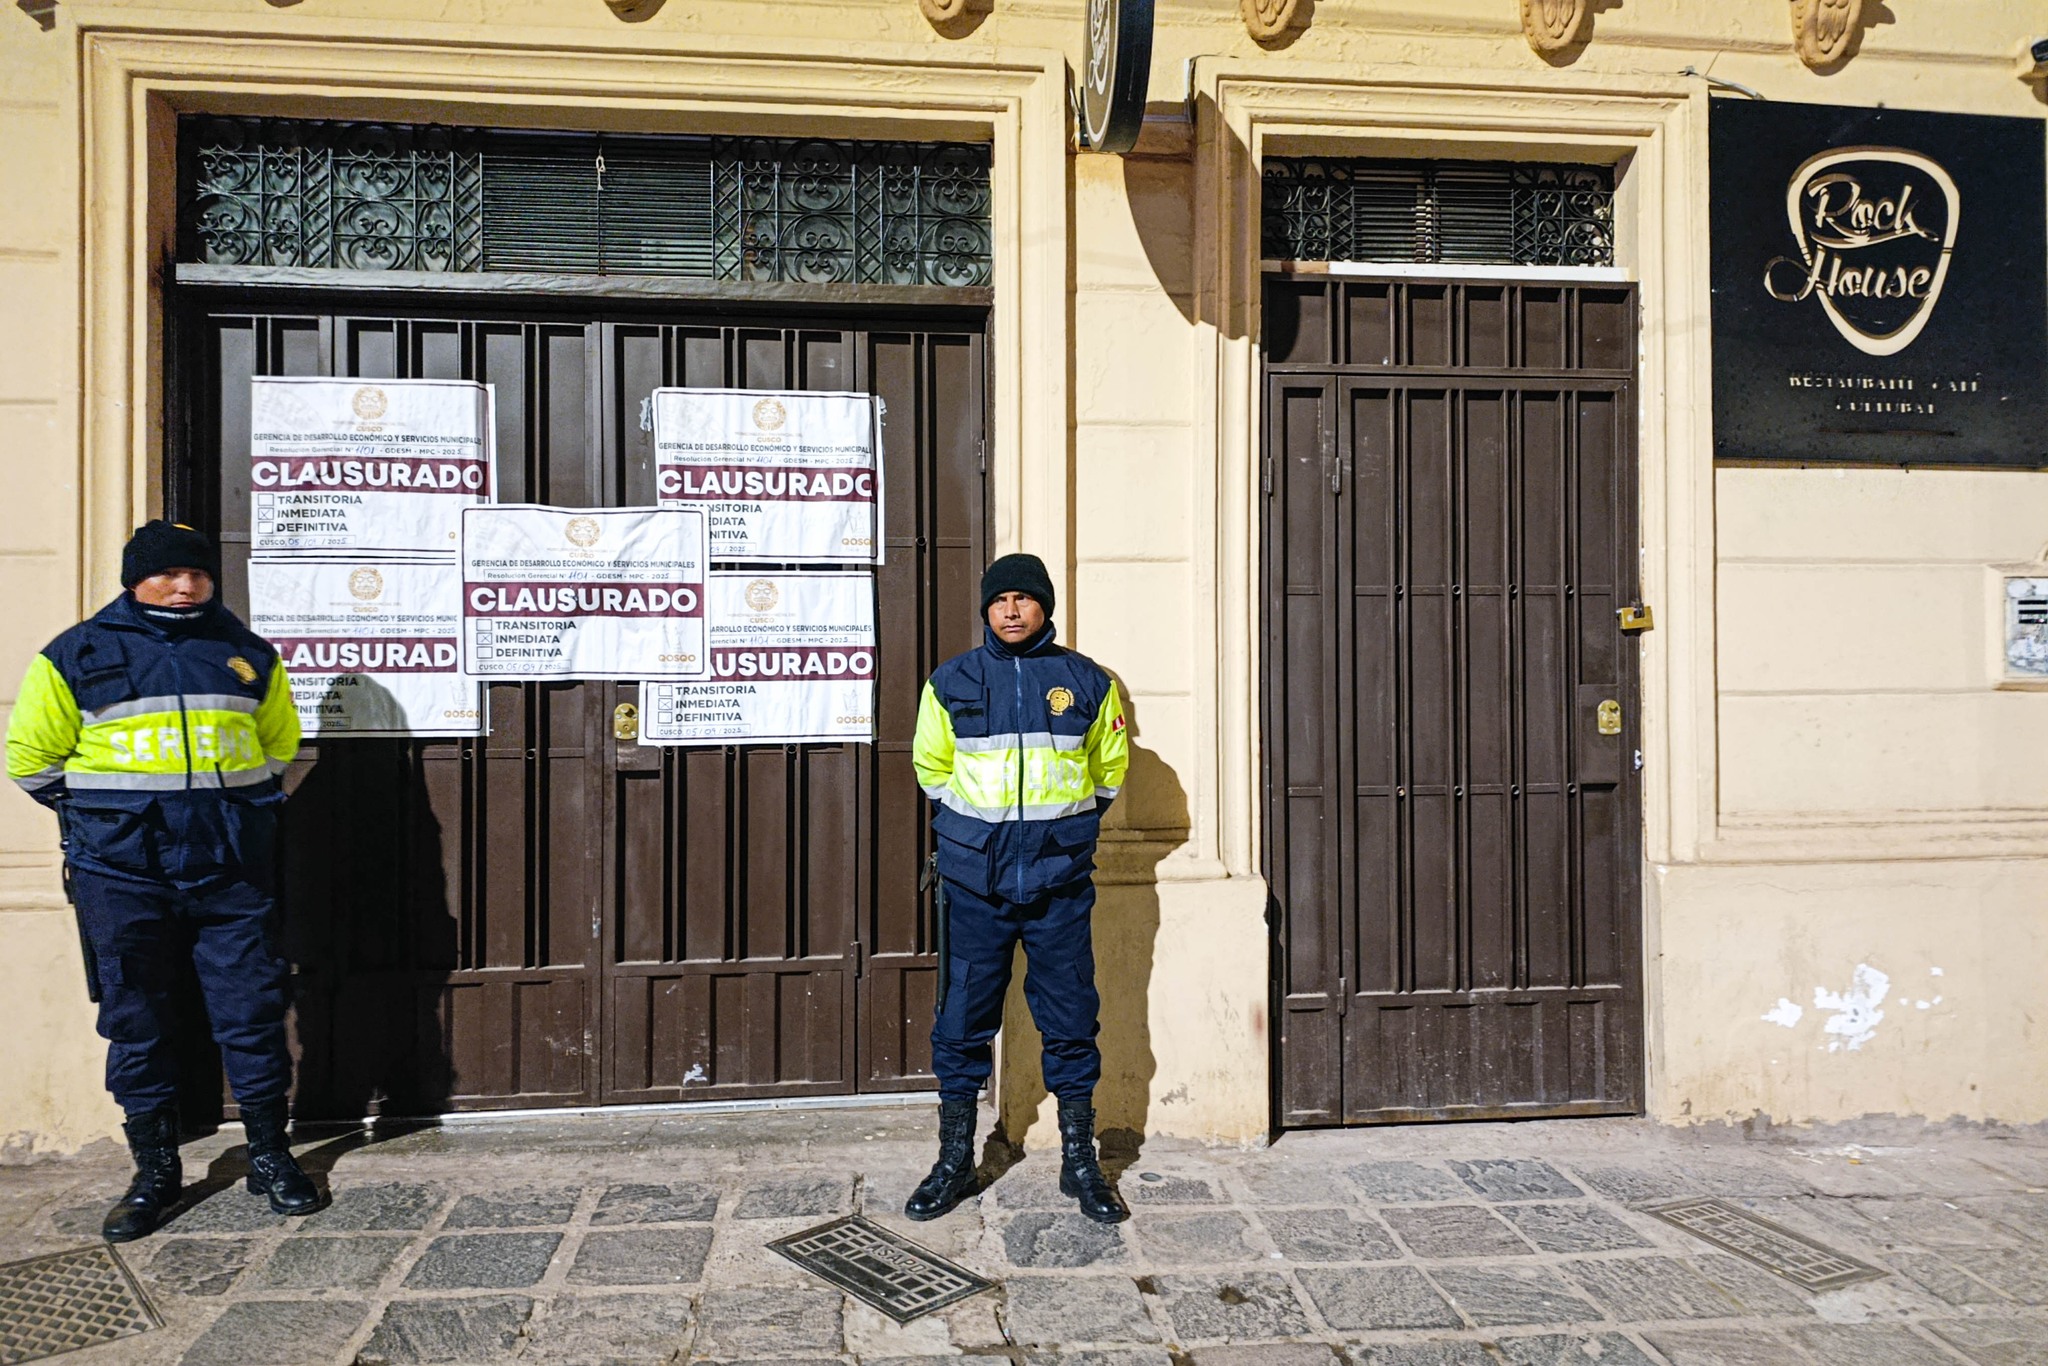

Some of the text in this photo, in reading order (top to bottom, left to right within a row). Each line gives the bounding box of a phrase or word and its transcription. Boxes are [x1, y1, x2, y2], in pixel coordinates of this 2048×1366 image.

[1807, 173, 1940, 246] Rock
[1764, 244, 1933, 301] House
[304, 433, 348, 441] DESARROLLO
[349, 433, 393, 442] ECONÓMICO
[401, 434, 439, 443] SERVICIOS
[659, 442, 693, 450] GERENCIA
[750, 444, 792, 452] ECONÓMICO
[251, 461, 484, 490] CLAUSURADO
[659, 469, 872, 497] CLAUSURADO
[277, 495, 363, 505] TRANSITORIA
[681, 503, 762, 512] NSITORIA
[277, 508, 346, 518] INMEDIATA
[276, 523, 348, 532] DEFINITIVA
[709, 530, 748, 540] NITIVA
[562, 560, 605, 568] ECONÓMICO
[612, 560, 649, 568] SERVICIOS
[470, 588, 698, 612] CLAUSURADO
[252, 614, 284, 622] ERENCIA
[286, 614, 295, 622] DE
[296, 614, 345, 622] DESARROLLO
[346, 614, 389, 622] ECONÓMICO
[397, 614, 434, 622] SERVICIOS
[495, 620, 577, 630] TRANSITORIA
[828, 624, 872, 632] MUNICIPALES
[496, 634, 560, 644] INMEDIATA
[496, 648, 563, 658] DEFINITIVA
[658, 654, 697, 662] QOSQO
[710, 651, 873, 677] USURADO
[290, 677, 358, 686] ANSITORIA
[294, 691, 342, 700] EDIATA
[675, 686, 756, 696] TRANSITORIA
[676, 699, 740, 708] INMEDIATA
[296, 704, 344, 714] NITIVA
[676, 712, 742, 722] DEFINITIVA
[109, 725, 251, 764] SERENO
